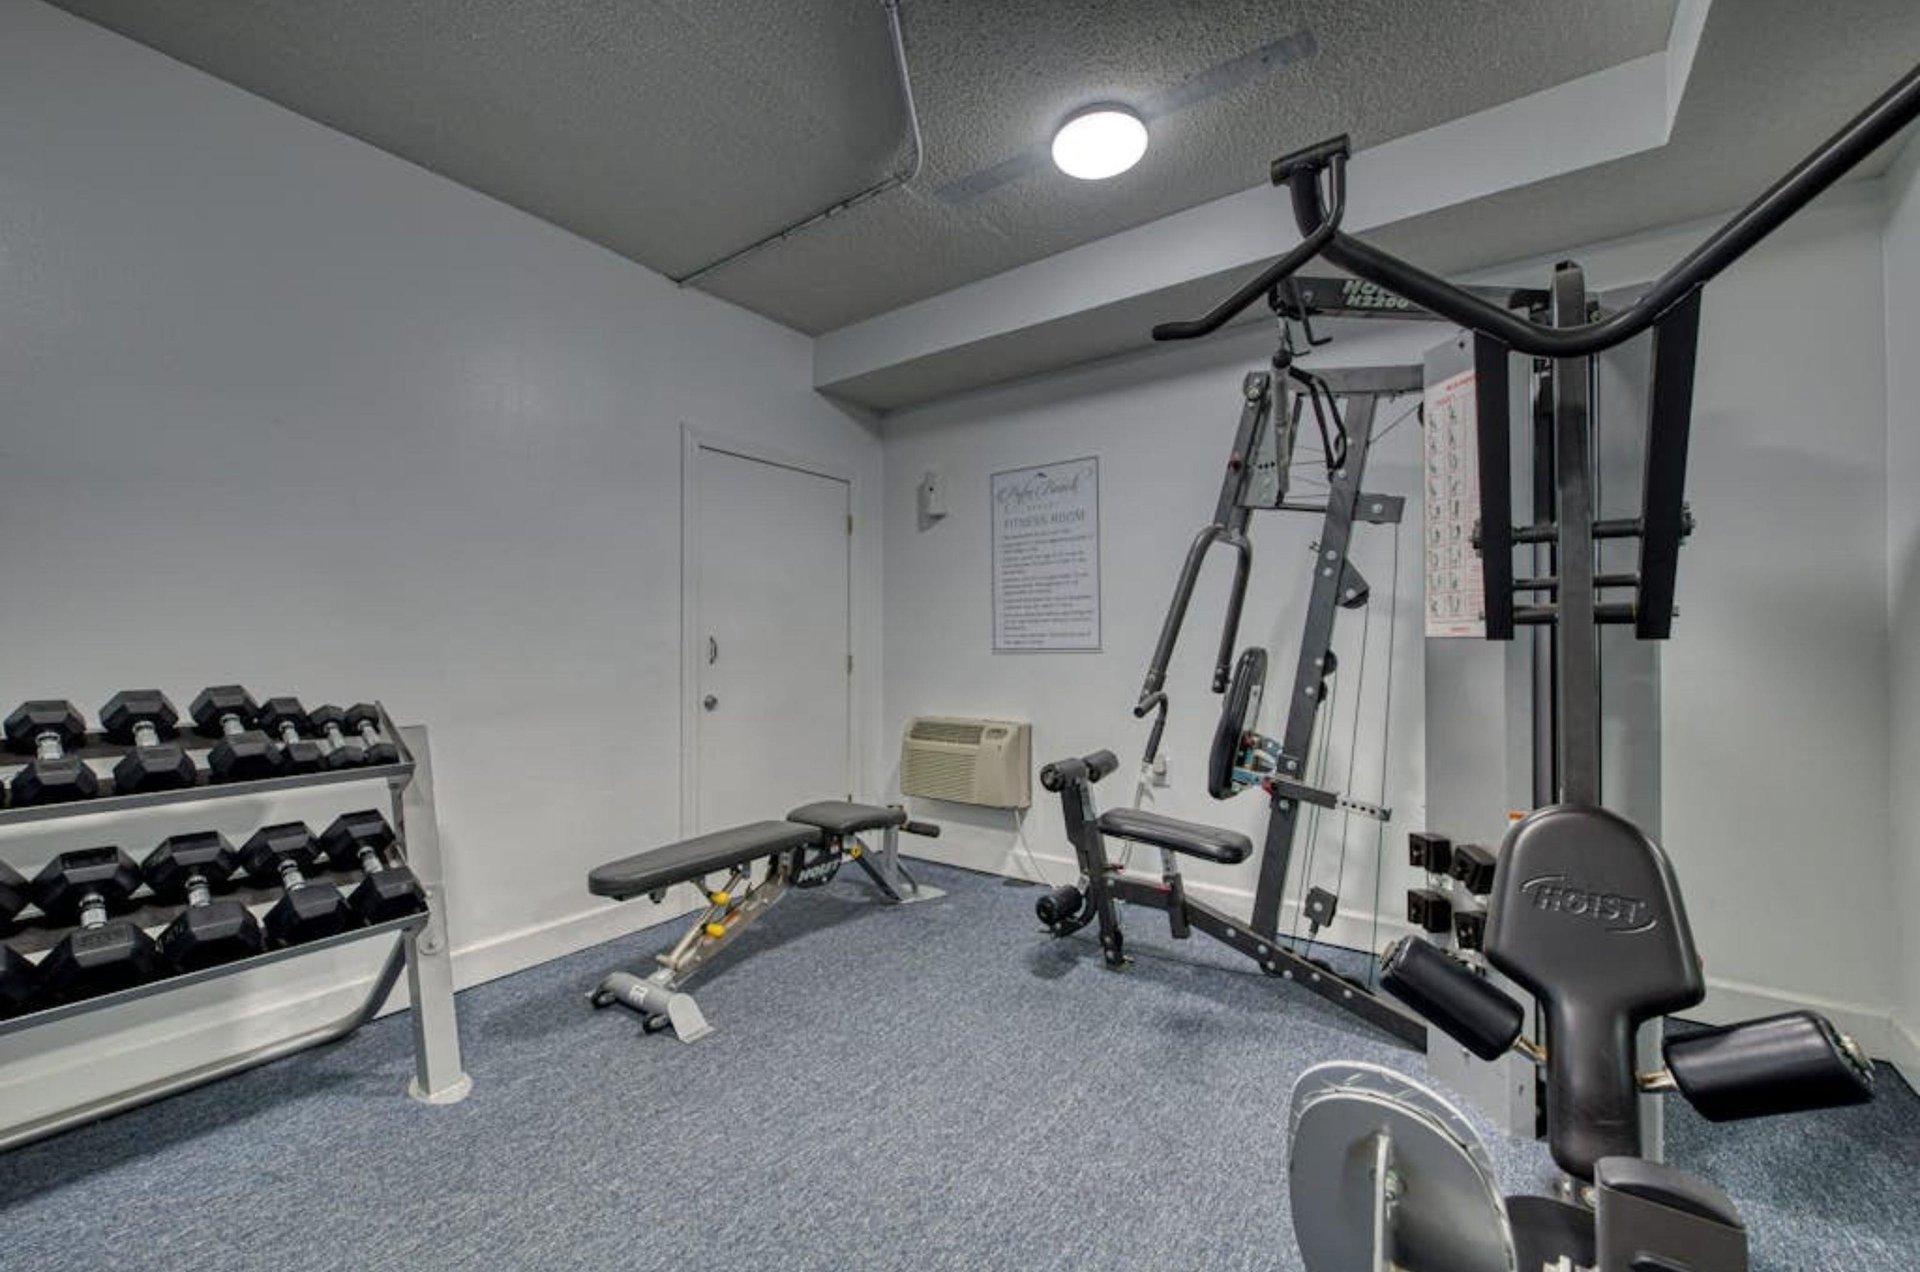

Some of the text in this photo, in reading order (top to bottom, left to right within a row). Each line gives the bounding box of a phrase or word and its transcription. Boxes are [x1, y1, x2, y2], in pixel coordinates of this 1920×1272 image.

[1003, 514, 1048, 529] FITNESS
[1050, 506, 1085, 523] ROOM
[1532, 884, 1643, 924] HOIST
